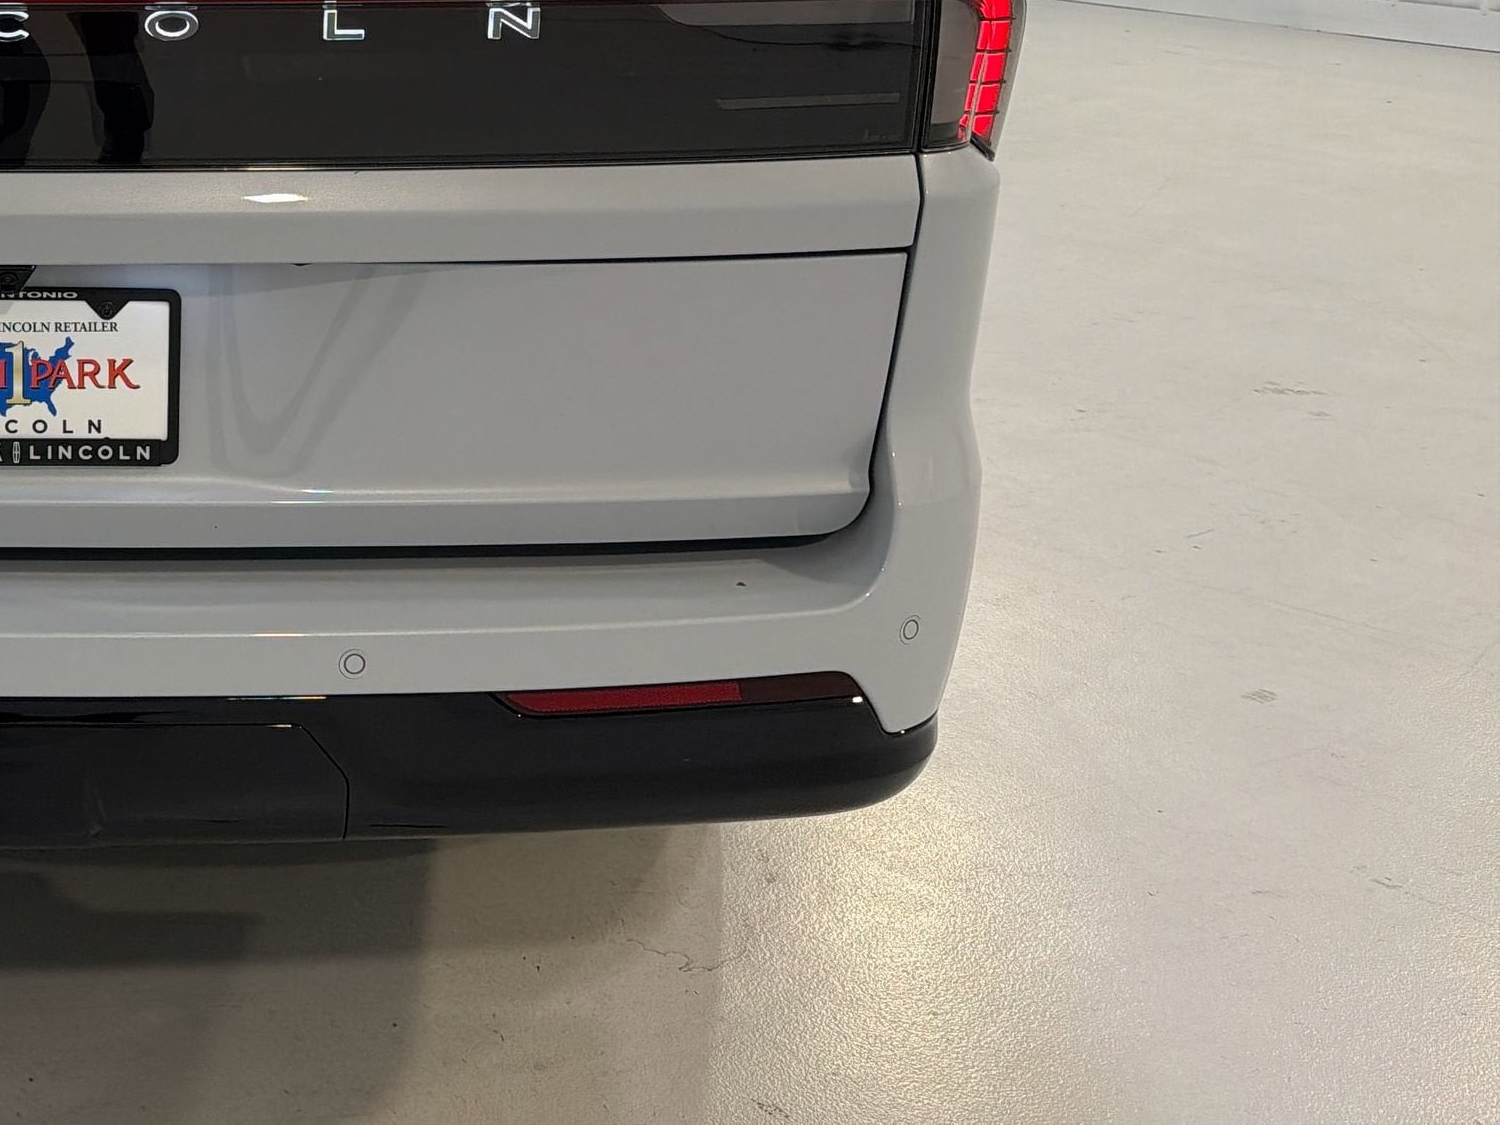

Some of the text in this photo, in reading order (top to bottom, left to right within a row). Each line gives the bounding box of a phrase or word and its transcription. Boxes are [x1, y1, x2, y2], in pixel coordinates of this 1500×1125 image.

[54, 321, 118, 333] RETAILER
[30, 358, 141, 390] PARK
[28, 445, 151, 461] LINCOLN
